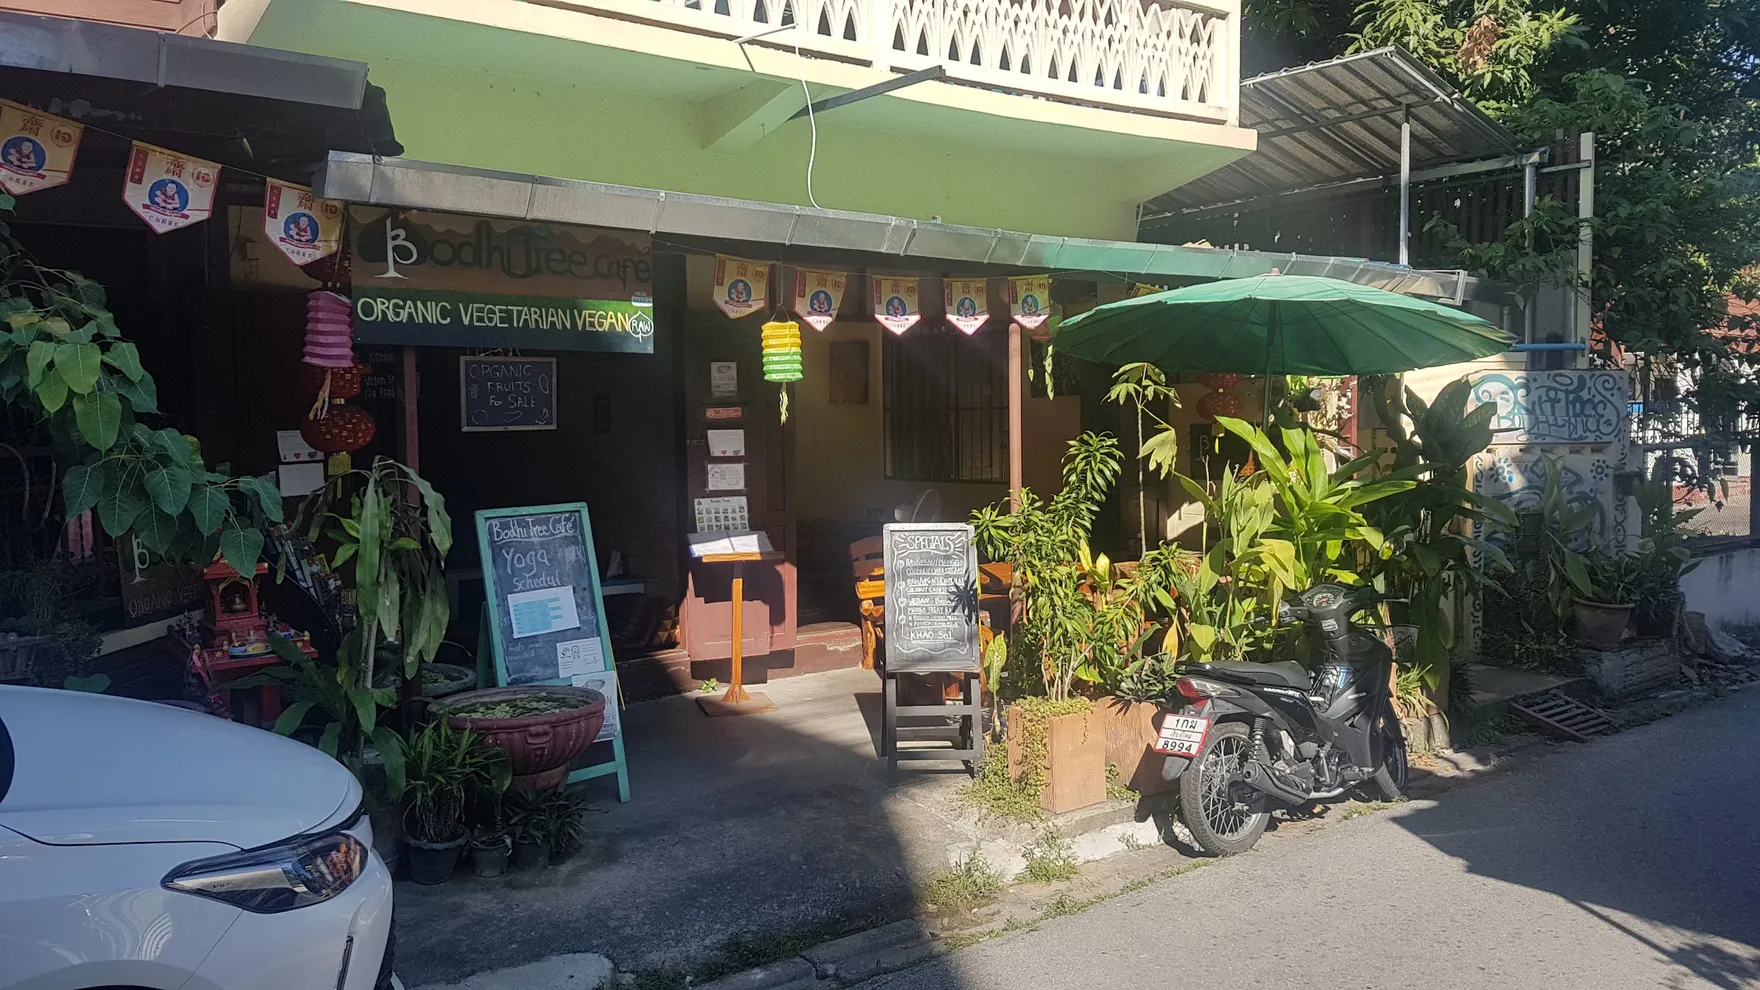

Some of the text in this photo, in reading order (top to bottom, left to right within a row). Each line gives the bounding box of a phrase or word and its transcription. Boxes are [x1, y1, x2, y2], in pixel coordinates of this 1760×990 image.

[357, 297, 651, 332] ORGANIC VEGETARIAN VEGAN RAW
[469, 364, 532, 379] ORGANIC
[487, 381, 532, 394] FRUITS
[492, 516, 576, 542] Bodhi Tree Café
[906, 535, 955, 555] SPECIALS
[502, 547, 551, 577] Yoga
[910, 630, 934, 640] KHAO
[1162, 740, 1193, 753] 8994
